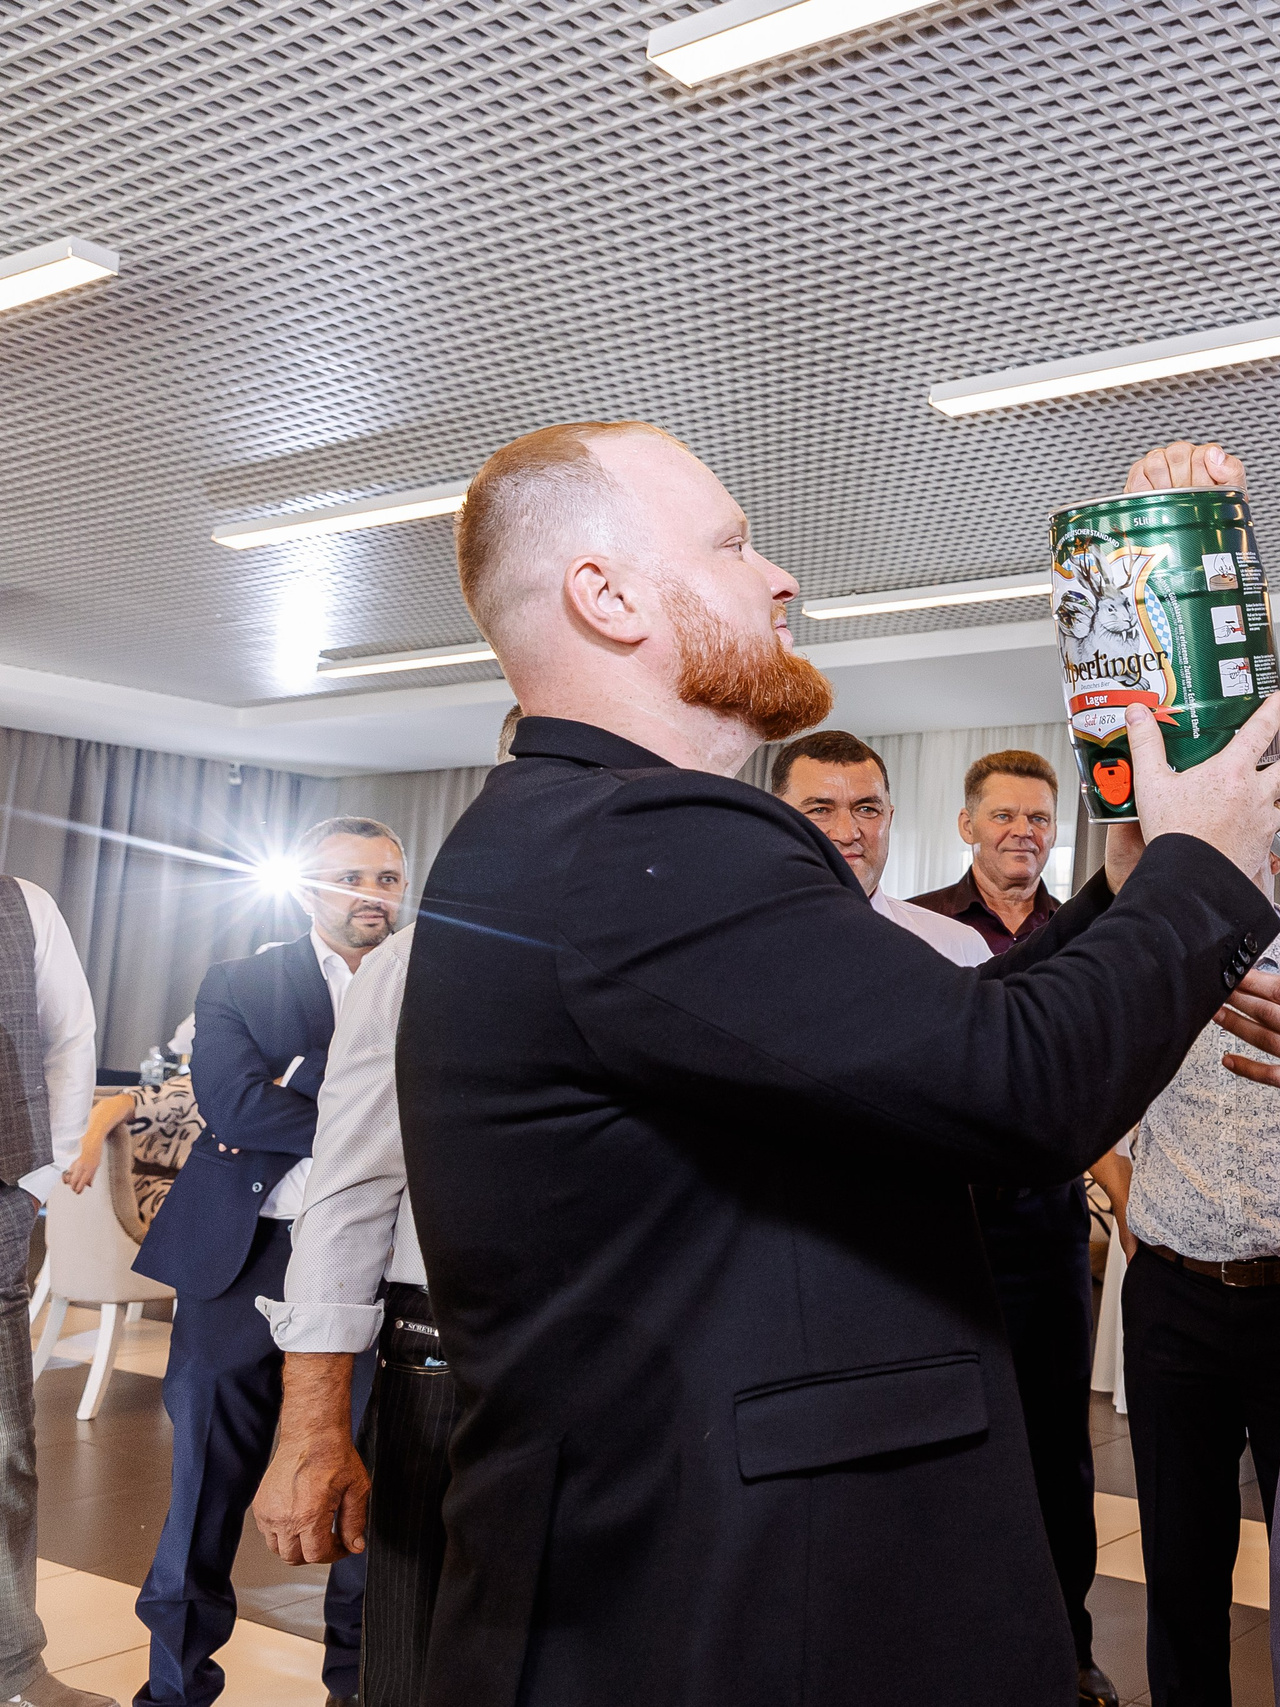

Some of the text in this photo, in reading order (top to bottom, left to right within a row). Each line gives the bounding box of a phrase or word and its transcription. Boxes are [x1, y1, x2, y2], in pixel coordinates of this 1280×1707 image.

[1090, 529, 1120, 548] STANDARD
[1081, 681, 1100, 690] Deutsches
[1085, 695, 1108, 706] Lager
[1183, 665, 1192, 689] Zutaten
[1191, 718, 1201, 739] Ehrlich
[1099, 714, 1116, 725] 1878
